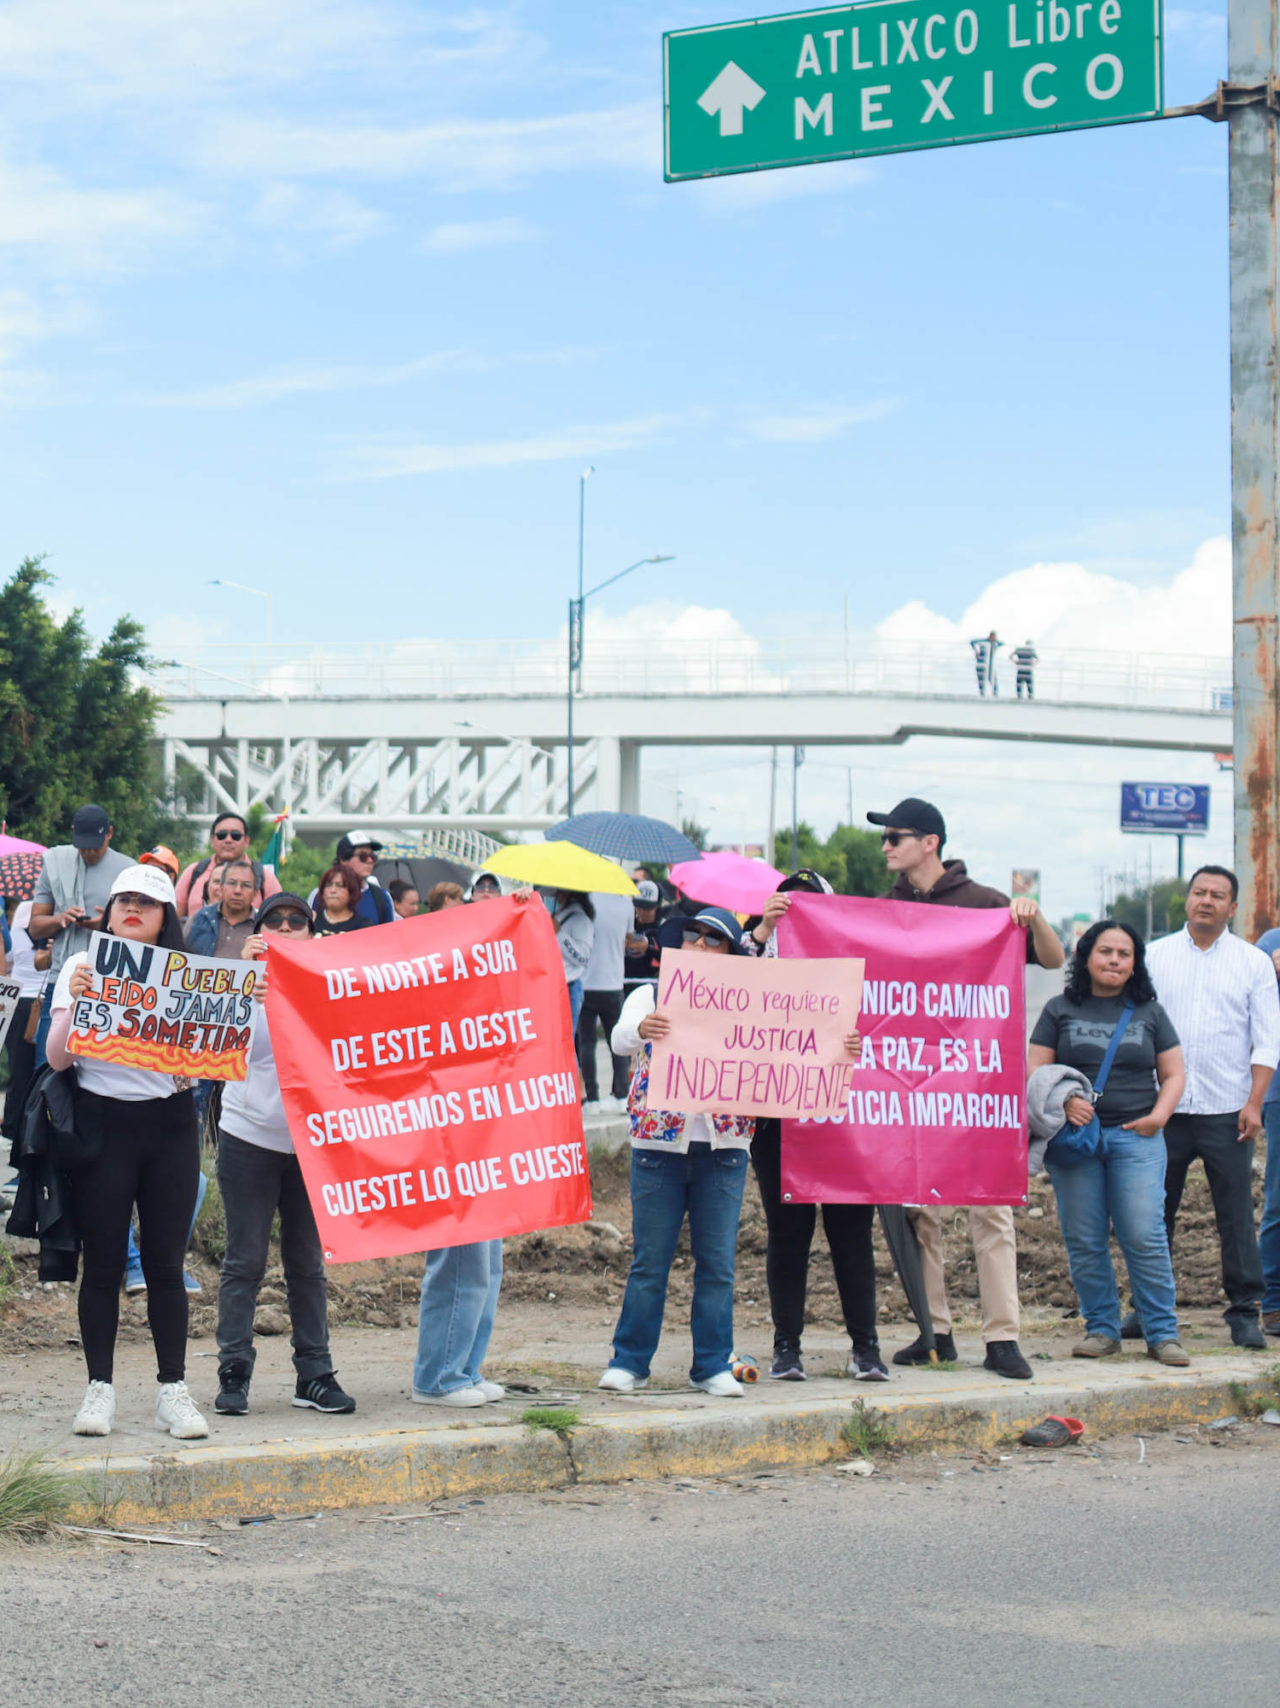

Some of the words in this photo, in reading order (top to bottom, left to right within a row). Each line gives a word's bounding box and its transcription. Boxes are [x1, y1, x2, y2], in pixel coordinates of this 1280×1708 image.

[795, 8, 979, 79] ATLIXCO
[1008, 0, 1122, 48] Libre
[794, 53, 1125, 140] MEXICO
[95, 938, 154, 983] UN
[162, 952, 256, 997] PUEBLO
[325, 968, 361, 1000] DE
[366, 953, 447, 994] NORTE
[451, 948, 470, 981] A
[474, 939, 517, 977] SUR
[663, 968, 750, 1012] México
[762, 990, 840, 1023] requiere
[73, 1001, 112, 1032] ES
[117, 1009, 251, 1051] SOMETIDO
[165, 990, 252, 1025] JAMÁS
[859, 980, 917, 1016] NICO
[923, 982, 1010, 1019] CAMINO
[331, 1036, 367, 1071] DE
[371, 1025, 433, 1066] ESTE
[440, 1021, 457, 1056] A
[460, 1008, 537, 1050] OESTE
[724, 1024, 818, 1056] JUSTICIA
[882, 1036, 933, 1077] PAZ,
[940, 1038, 969, 1073] ES
[974, 1039, 1003, 1073] LA
[306, 1092, 465, 1147] SEGUIREMOS
[467, 1085, 502, 1121] EN
[506, 1071, 576, 1115] LUCHA
[666, 1053, 854, 1110] INDEPENDIENTE
[799, 1090, 904, 1127] TICIA
[908, 1092, 1022, 1129] IMPARCIAL
[322, 1172, 416, 1216] CUESTE
[419, 1166, 451, 1202] LO
[455, 1157, 507, 1198] QUE
[509, 1142, 585, 1186] CUESTE
